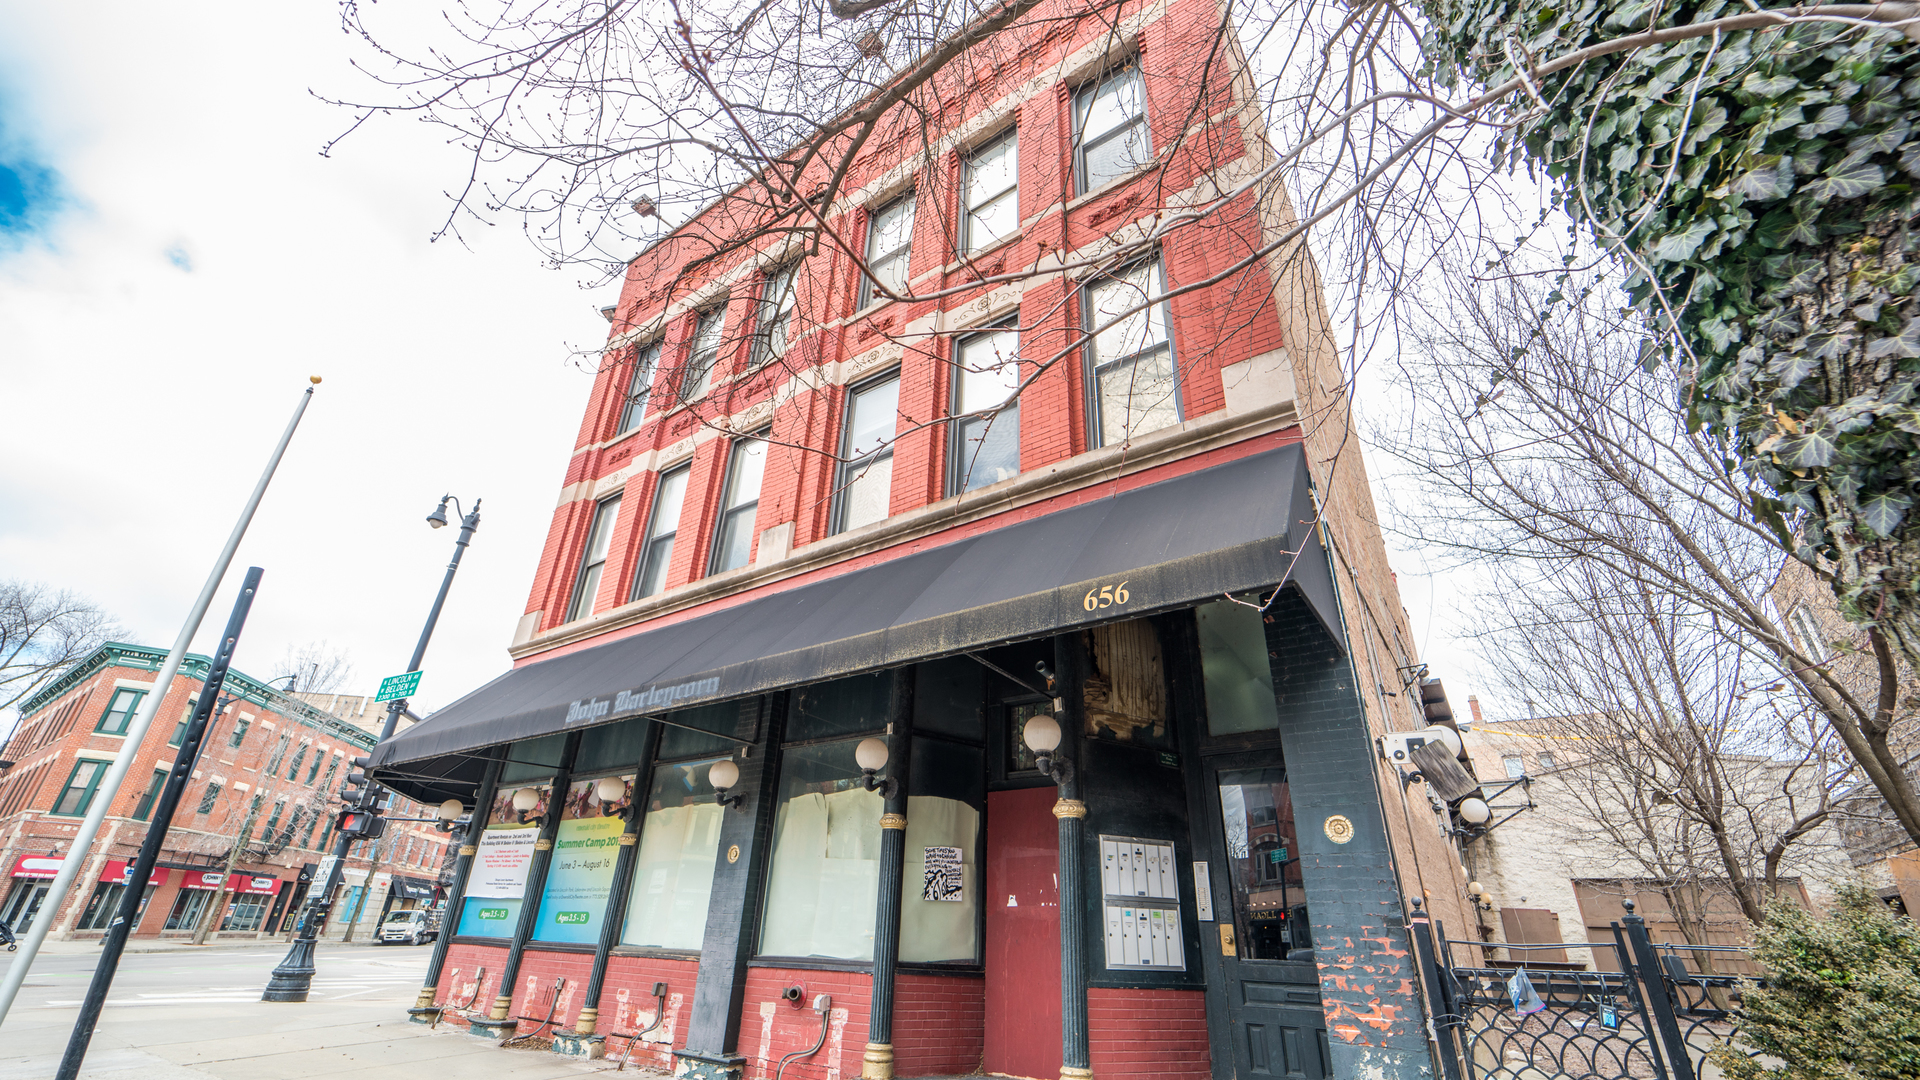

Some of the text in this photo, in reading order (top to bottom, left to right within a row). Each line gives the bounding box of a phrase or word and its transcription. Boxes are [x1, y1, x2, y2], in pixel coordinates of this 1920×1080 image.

[1083, 581, 1130, 611] 656
[388, 674, 412, 685] LINCOLN
[385, 683, 409, 693] BELDEN
[565, 676, 720, 722] John Barleycorn
[557, 836, 621, 849] Summer Camp 201
[559, 860, 572, 870] June
[572, 860, 577, 869] 3
[582, 860, 602, 871] August
[603, 858, 611, 868] 16
[480, 910, 491, 919] Ages
[490, 910, 498, 918] 3.5
[500, 910, 506, 918] 15
[557, 913, 569, 924] Ages
[568, 913, 577, 922] 3.5
[580, 913, 587, 922] 15
